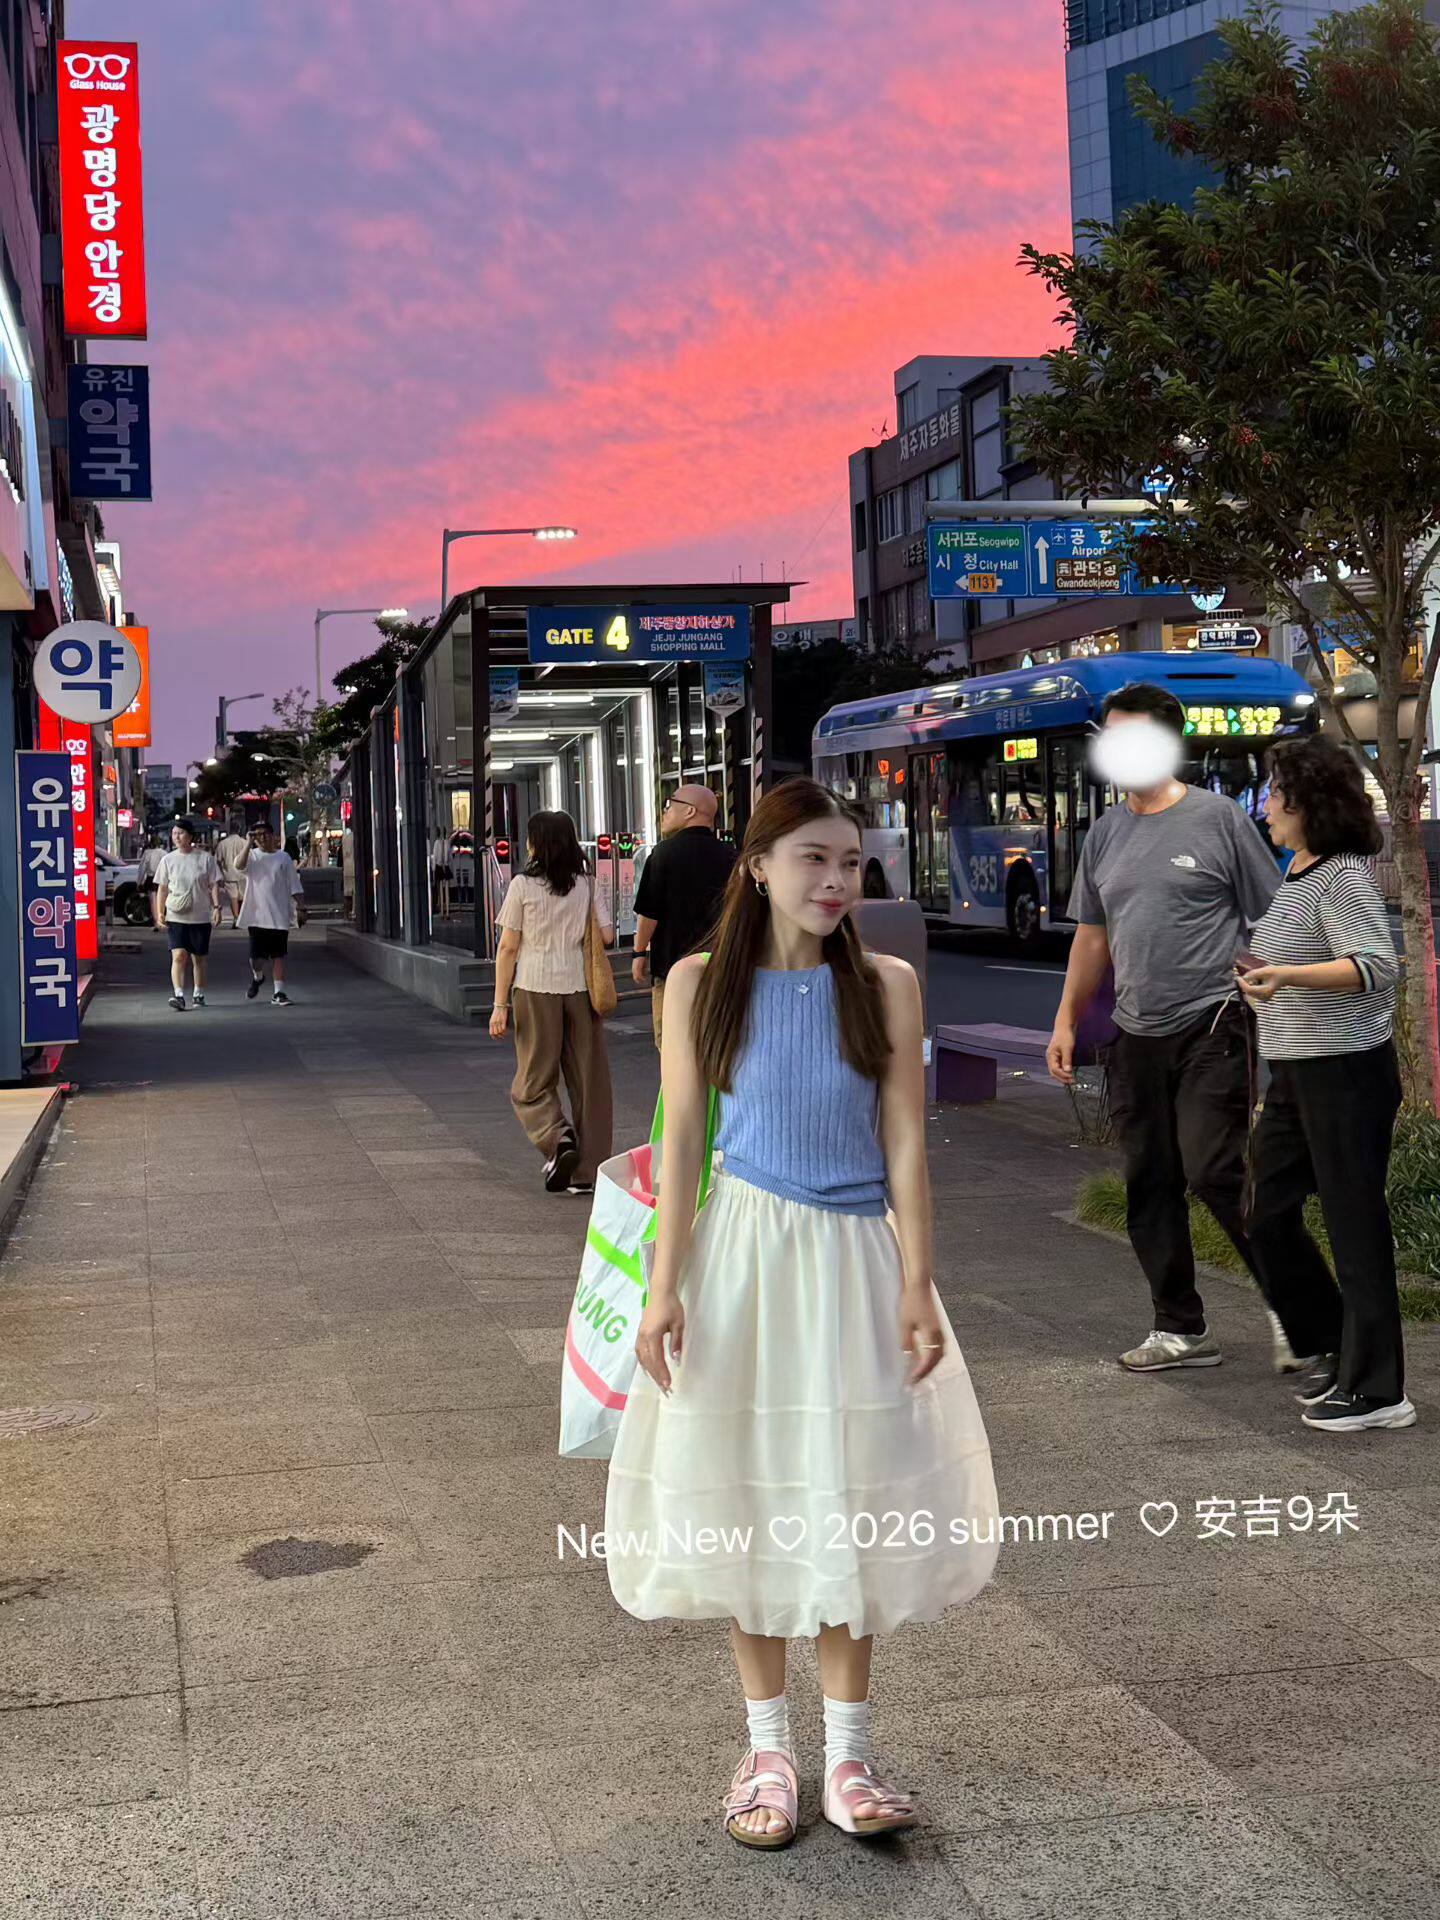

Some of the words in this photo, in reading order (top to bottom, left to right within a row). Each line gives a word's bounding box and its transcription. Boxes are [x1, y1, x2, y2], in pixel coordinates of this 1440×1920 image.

[69, 79, 94, 90] Glass
[96, 80, 126, 91] House
[82, 368, 134, 392] 유진
[79, 397, 139, 492] 약국
[937, 532, 978, 547] 서귀포
[979, 537, 1020, 548] Seogwipo
[1072, 546, 1107, 557] Airport
[979, 560, 998, 572] City
[1000, 560, 1019, 570] Hall
[970, 575, 996, 590] 1131
[1056, 577, 1120, 590] Gwandeokjeong
[545, 628, 594, 645] GATE
[606, 615, 630, 651] 4
[652, 633, 676, 642] JEJU
[678, 632, 723, 642] JUNGANG
[650, 643, 697, 652] SHOPPING
[700, 642, 726, 651] MALL
[49, 639, 124, 710] 약
[27, 777, 72, 1008] 유진약국
